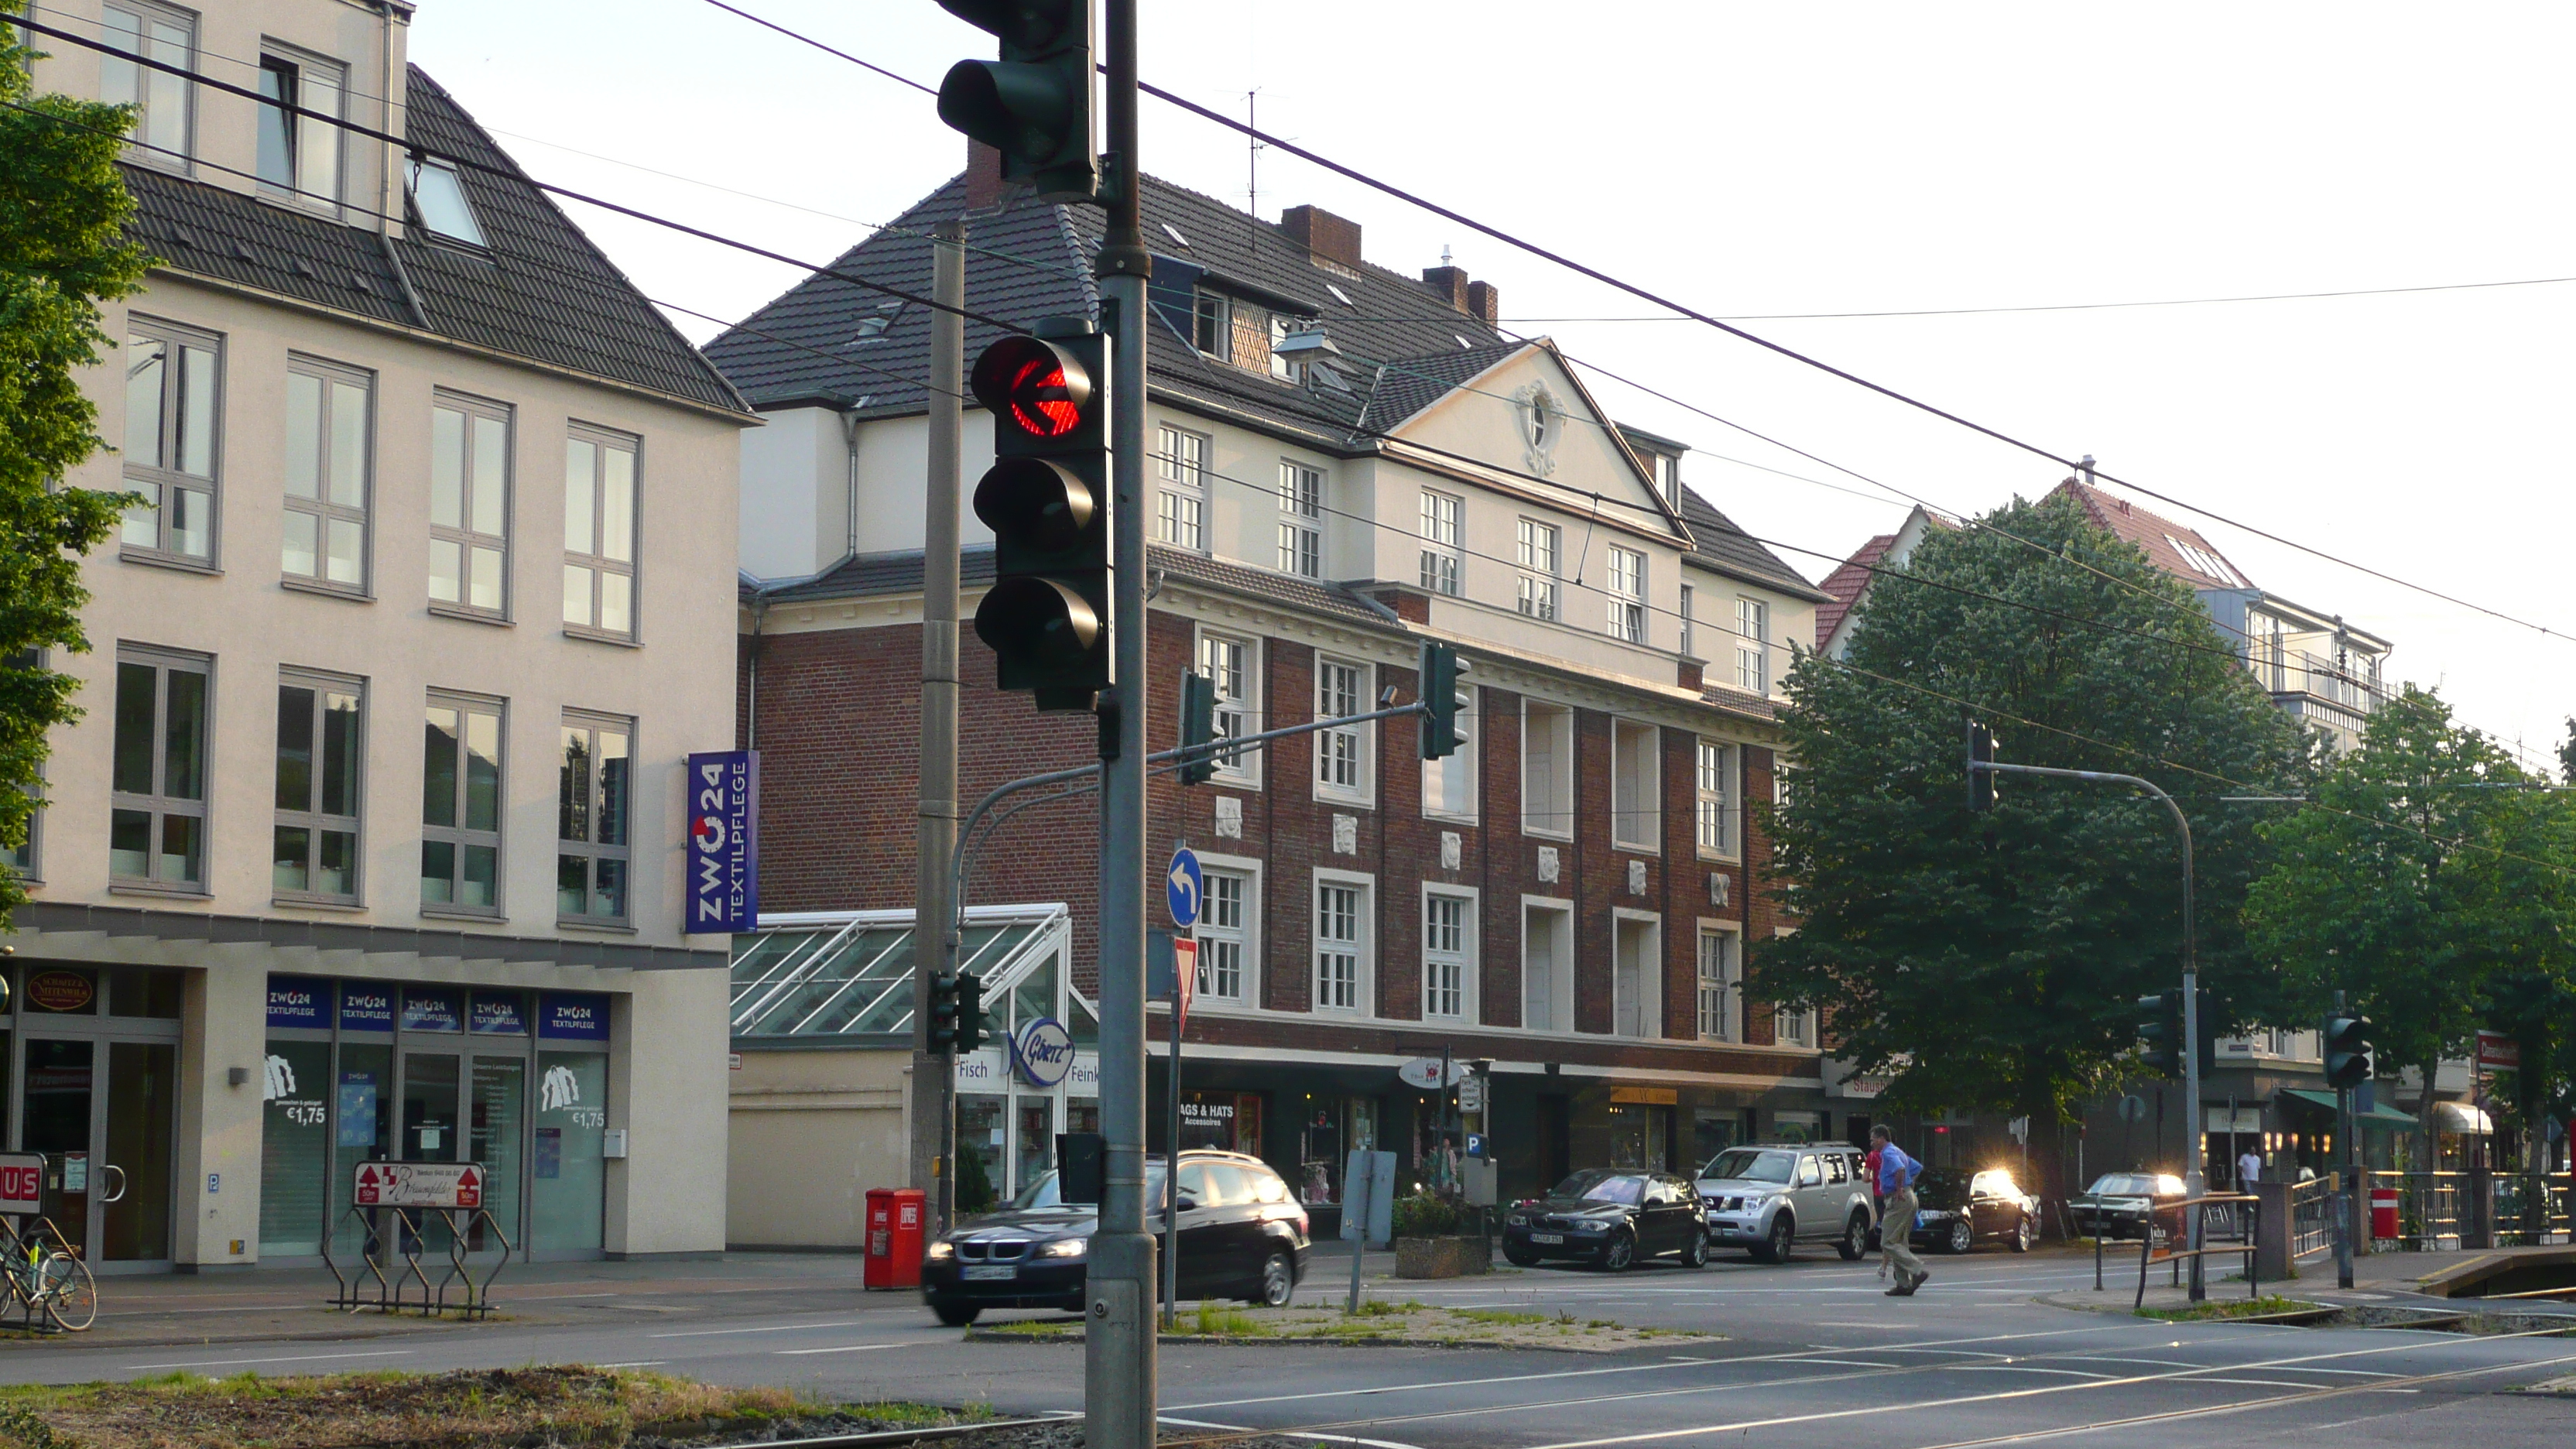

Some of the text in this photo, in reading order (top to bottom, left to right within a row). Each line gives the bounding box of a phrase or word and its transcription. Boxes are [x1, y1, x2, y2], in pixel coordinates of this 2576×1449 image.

[730, 762, 746, 922] TEXTILPFLEGE
[266, 1006, 315, 1016] TEXTILPFLEGE
[342, 1009, 391, 1019] TEXTILPFLEGE
[405, 1012, 452, 1022] TEXTILPFLEGE
[474, 1016, 519, 1026] TEXTILPFLEGE
[552, 1020, 594, 1029] TEXTILPFLEGE
[959, 1060, 988, 1078] Fisch
[286, 1107, 325, 1126] €1,75
[1201, 1104, 1208, 1116] &
[1210, 1105, 1234, 1118] HATS
[573, 1112, 605, 1129] €1,75
[1184, 1117, 1221, 1126] Accessoires
[1468, 1137, 1478, 1151] P
